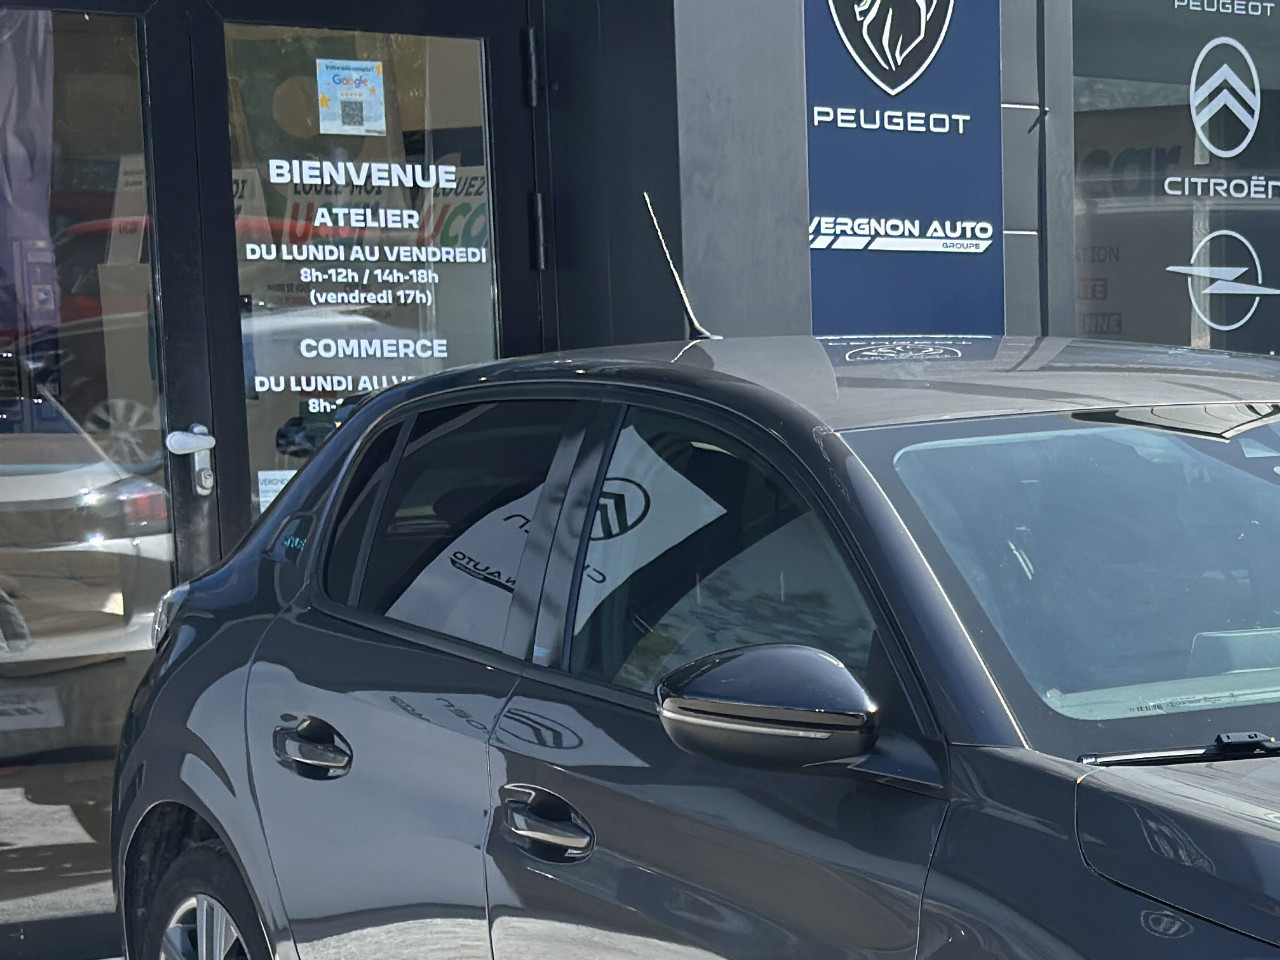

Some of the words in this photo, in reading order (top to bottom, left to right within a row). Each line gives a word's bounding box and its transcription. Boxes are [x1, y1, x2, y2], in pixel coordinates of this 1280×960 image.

[1174, 0, 1275, 16] PEUGEOT
[332, 73, 368, 89] Google
[813, 106, 971, 134] PEUGEOT
[268, 159, 457, 189] BIENVENUE
[313, 207, 420, 229] ATELIER
[926, 220, 993, 239] AUTO
[245, 243, 277, 260] DU
[282, 244, 345, 261] LUNDI
[350, 245, 380, 262] AU
[384, 246, 487, 263] VENDREDI
[941, 242, 981, 250] GROUPE
[300, 268, 359, 283] 8h-12h
[362, 269, 370, 285] /
[374, 268, 439, 284] 14h-18h
[309, 289, 393, 305] (vendredi
[396, 290, 433, 306] 17h)
[300, 338, 448, 358] COMMERCE
[254, 375, 285, 392] DU
[290, 375, 352, 392] LUNDI
[358, 375, 388, 391] AU
